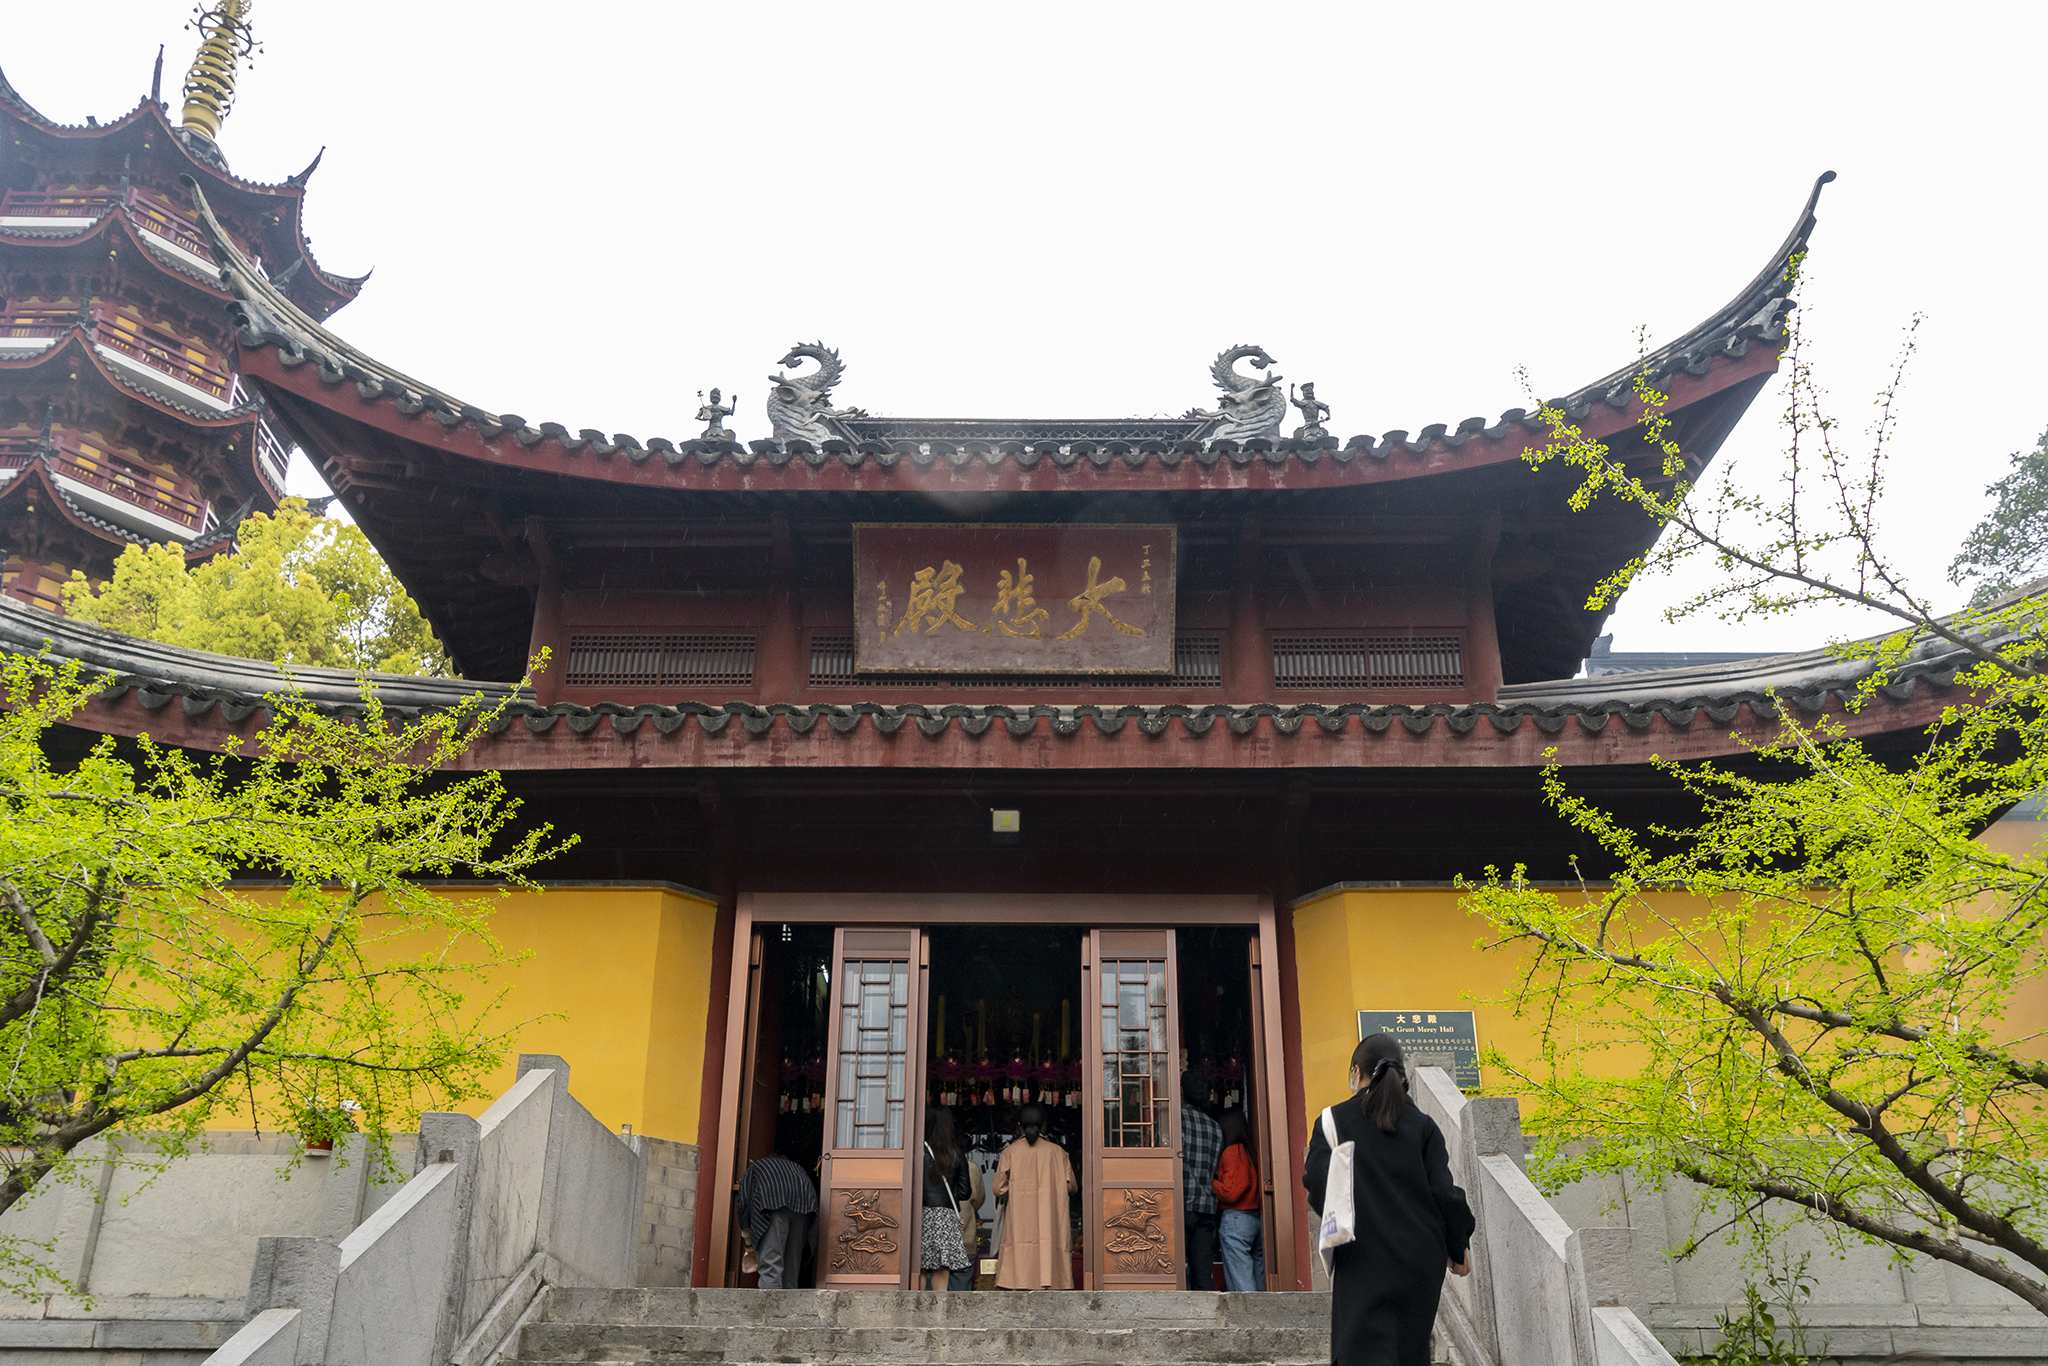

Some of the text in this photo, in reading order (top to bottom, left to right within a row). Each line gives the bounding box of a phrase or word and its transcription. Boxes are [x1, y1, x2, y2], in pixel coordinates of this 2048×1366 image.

[893, 556, 1145, 641] 大悲殿
[1396, 1014, 1438, 1024] 大悲殿
[1417, 1026, 1438, 1034] Mercy
